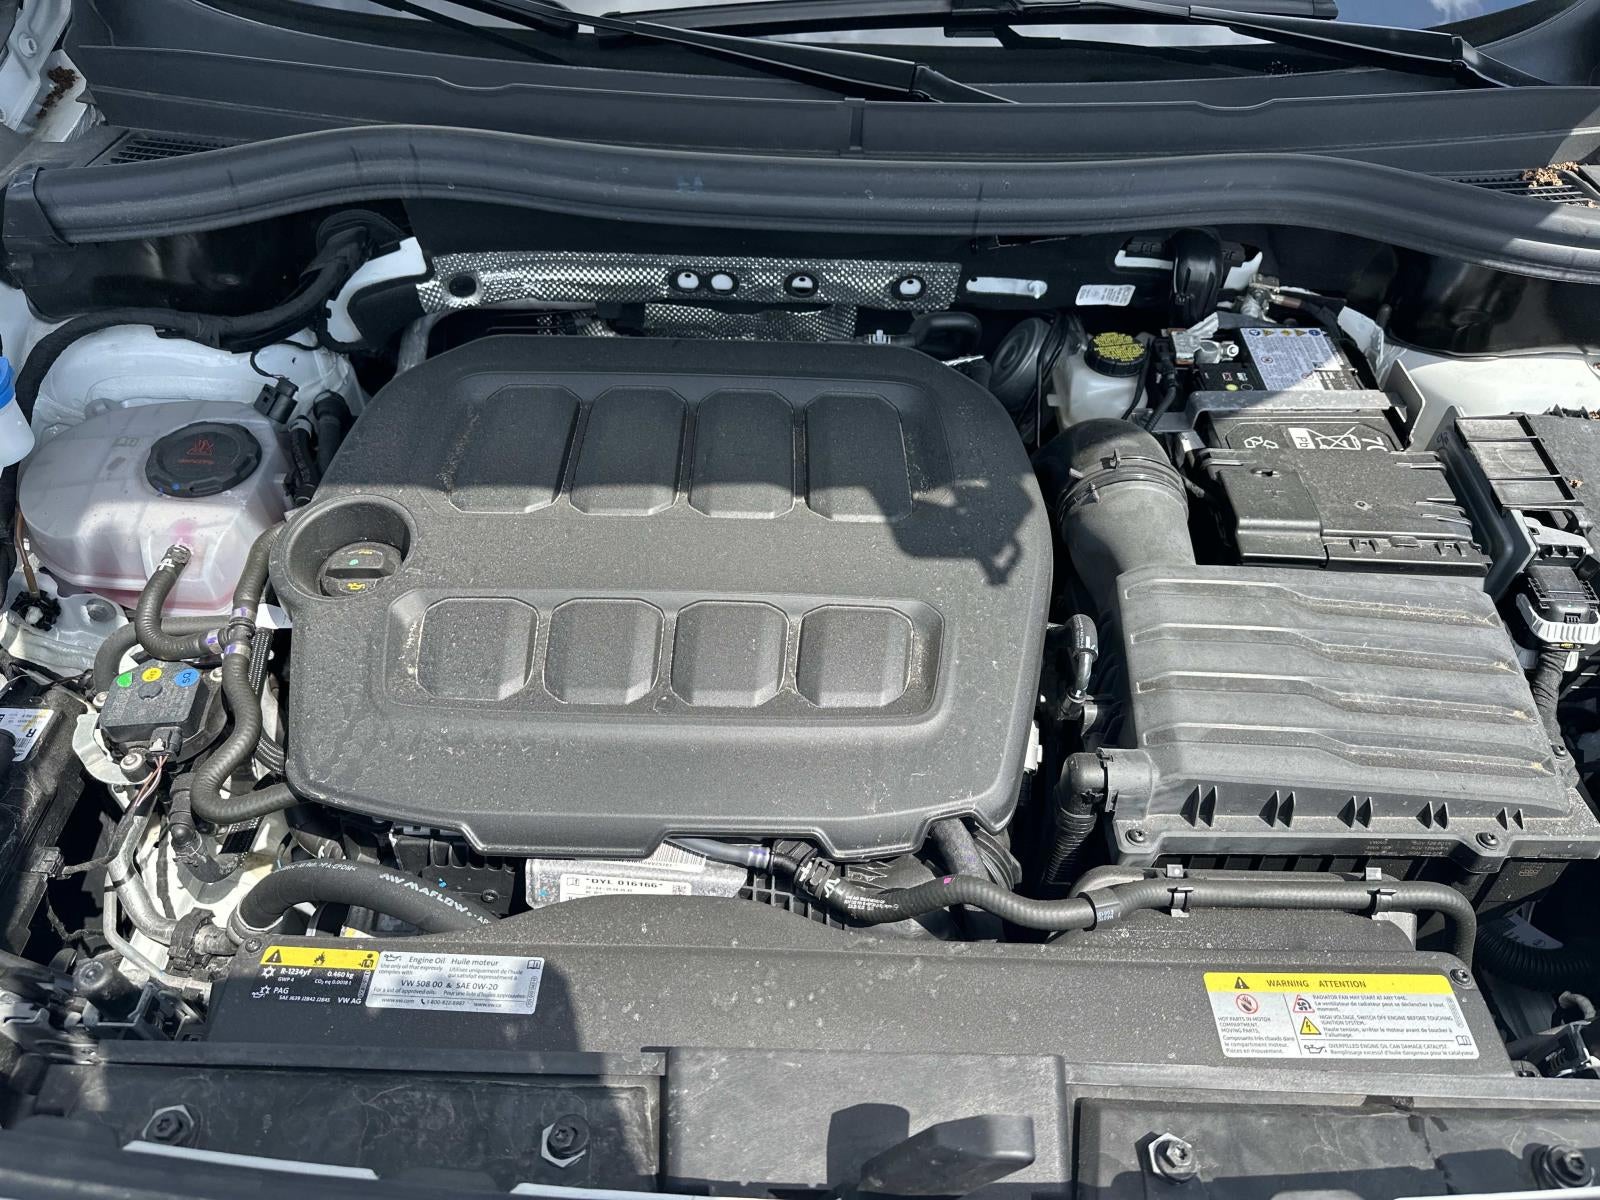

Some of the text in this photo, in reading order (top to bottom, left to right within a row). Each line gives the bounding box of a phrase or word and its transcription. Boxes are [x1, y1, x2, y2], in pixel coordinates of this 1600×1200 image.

[409, 956, 446, 965] Engine Oil
[451, 957, 499, 967] Huile moteur
[280, 967, 312, 977] R-1234yf
[346, 971, 355, 979] kg
[1319, 980, 1367, 988] ATTENTION
